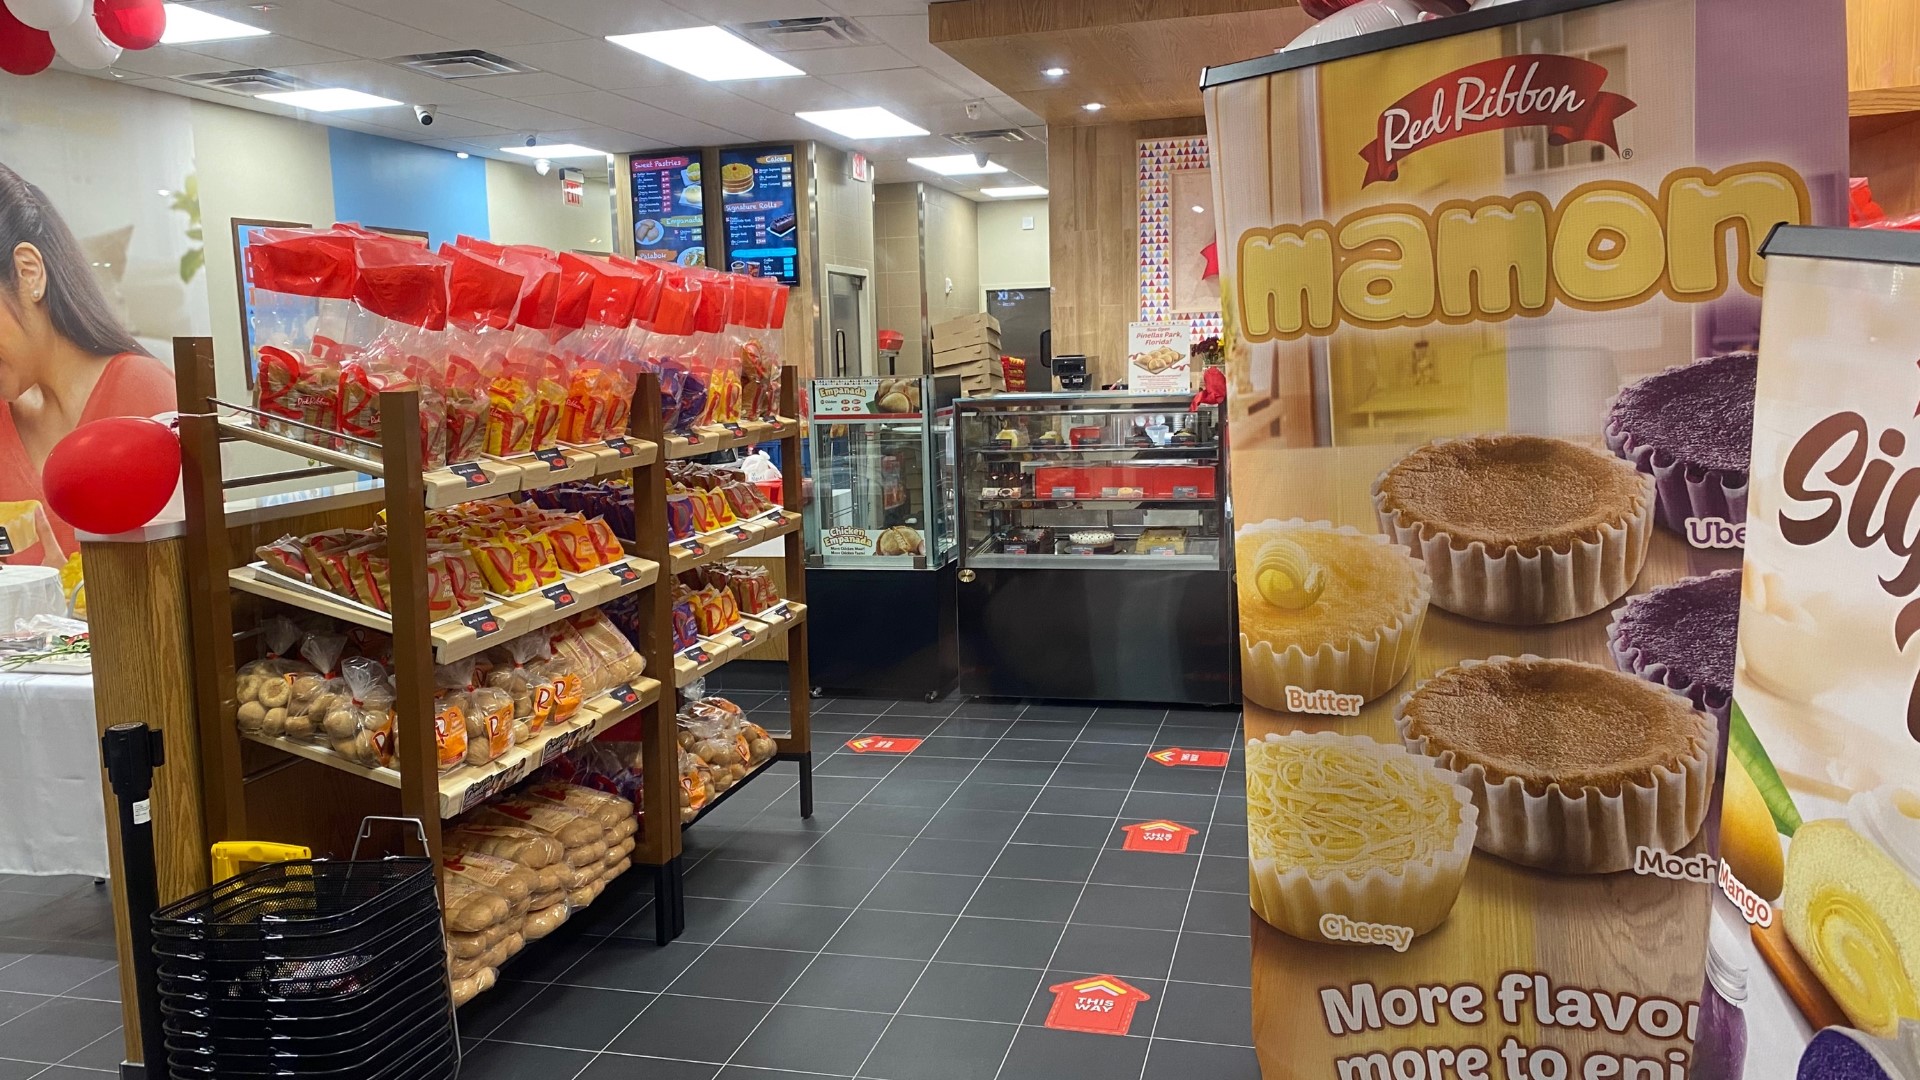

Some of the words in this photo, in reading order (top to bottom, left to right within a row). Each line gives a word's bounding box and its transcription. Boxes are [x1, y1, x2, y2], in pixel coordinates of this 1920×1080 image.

[1384, 87, 1451, 162] Red
[1455, 61, 1586, 131] Ribbon
[634, 161, 654, 169] Sweet
[654, 159, 681, 167] Pastries
[725, 203, 757, 213] Signature
[758, 201, 777, 209] Rolls
[1242, 163, 1806, 339] mamon
[1136, 331, 1163, 339] Pinellas
[819, 386, 867, 398] Empanada
[829, 526, 865, 537] Chicken
[1689, 521, 1746, 545] Ube
[823, 536, 872, 547] Empanada
[1288, 688, 1361, 714] Butter
[1719, 862, 1769, 923] Mango
[1321, 916, 1411, 950] Cheesy
[1074, 1003, 1114, 1013] WAY
[1077, 997, 1114, 1007] THIS
[1319, 982, 1484, 1035] More
[1336, 1047, 1490, 1080] more
